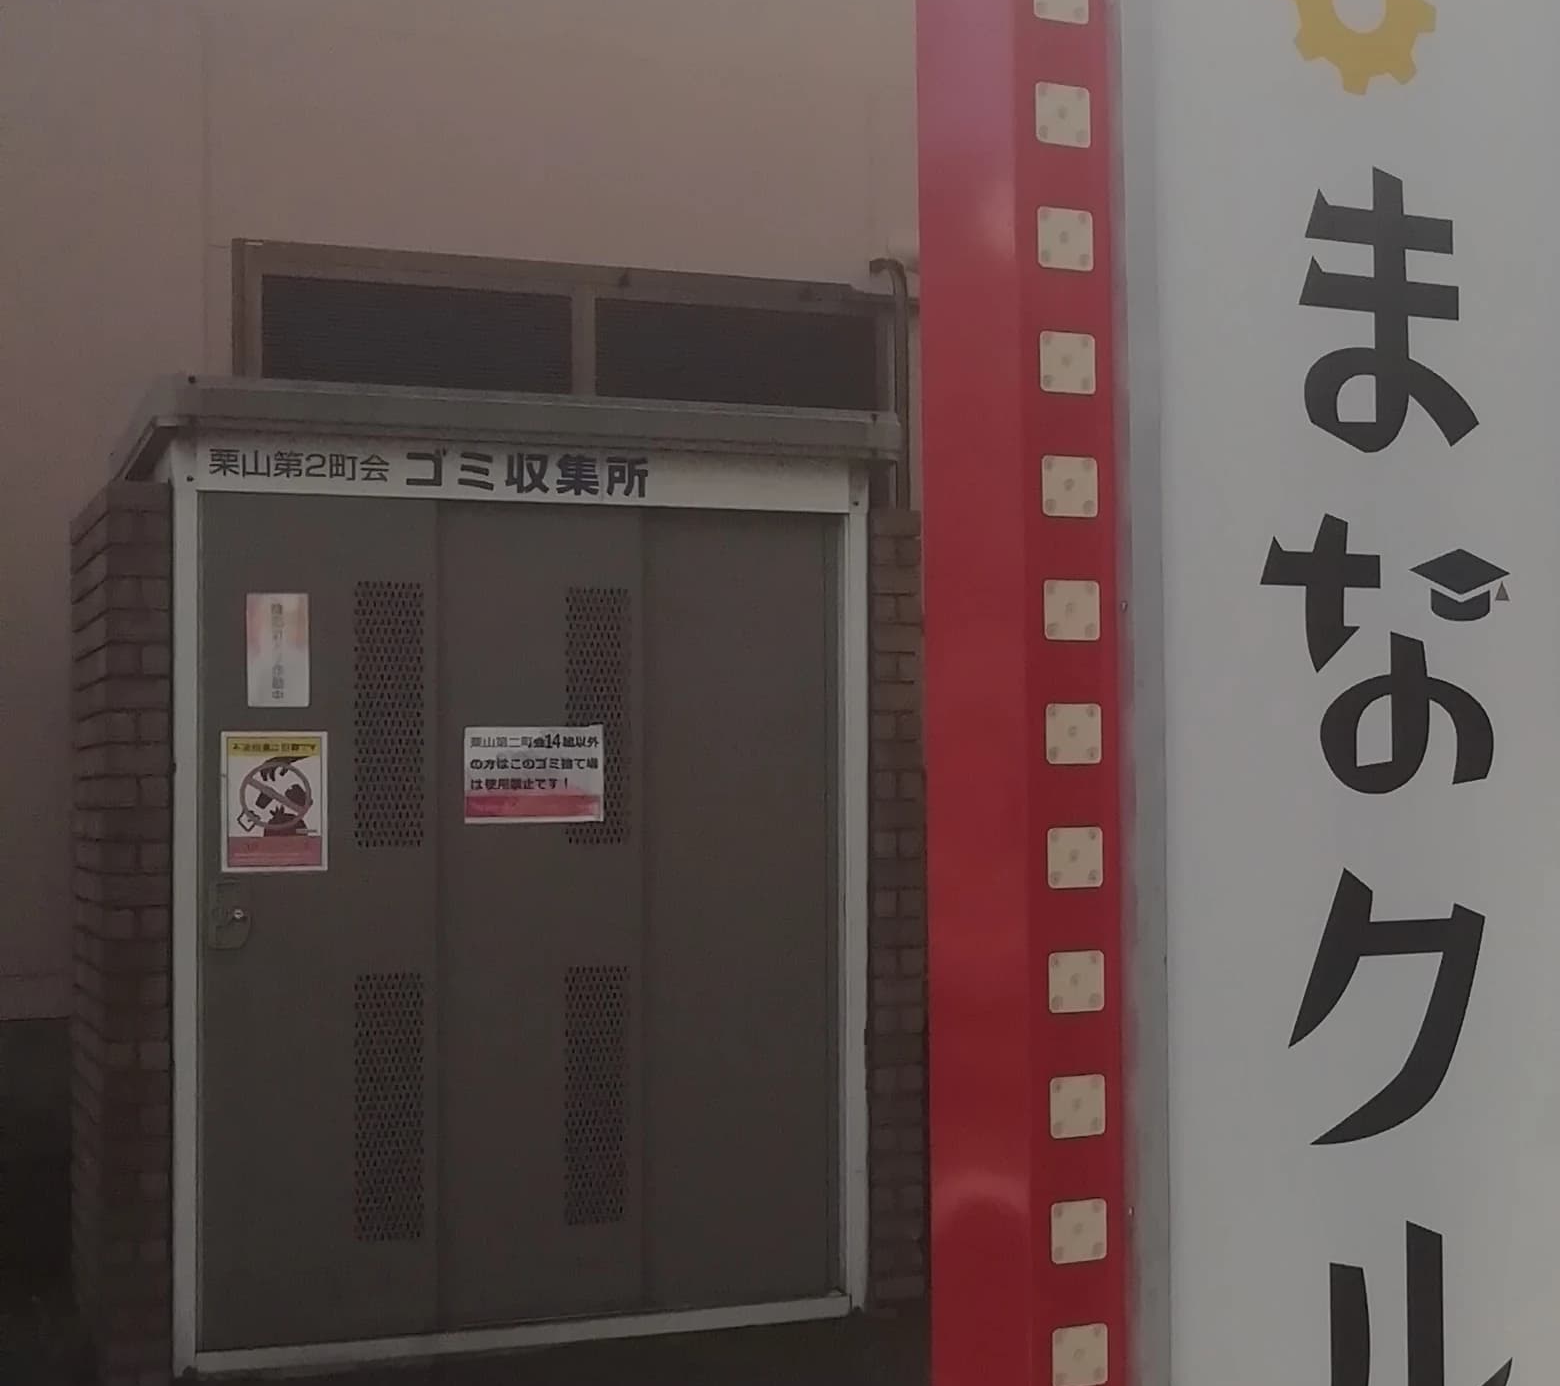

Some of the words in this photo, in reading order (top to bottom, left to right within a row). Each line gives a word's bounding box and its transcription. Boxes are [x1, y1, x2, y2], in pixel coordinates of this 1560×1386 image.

[208, 448, 390, 483] 栗山第2町会
[405, 447, 650, 498] ゴミ収集所
